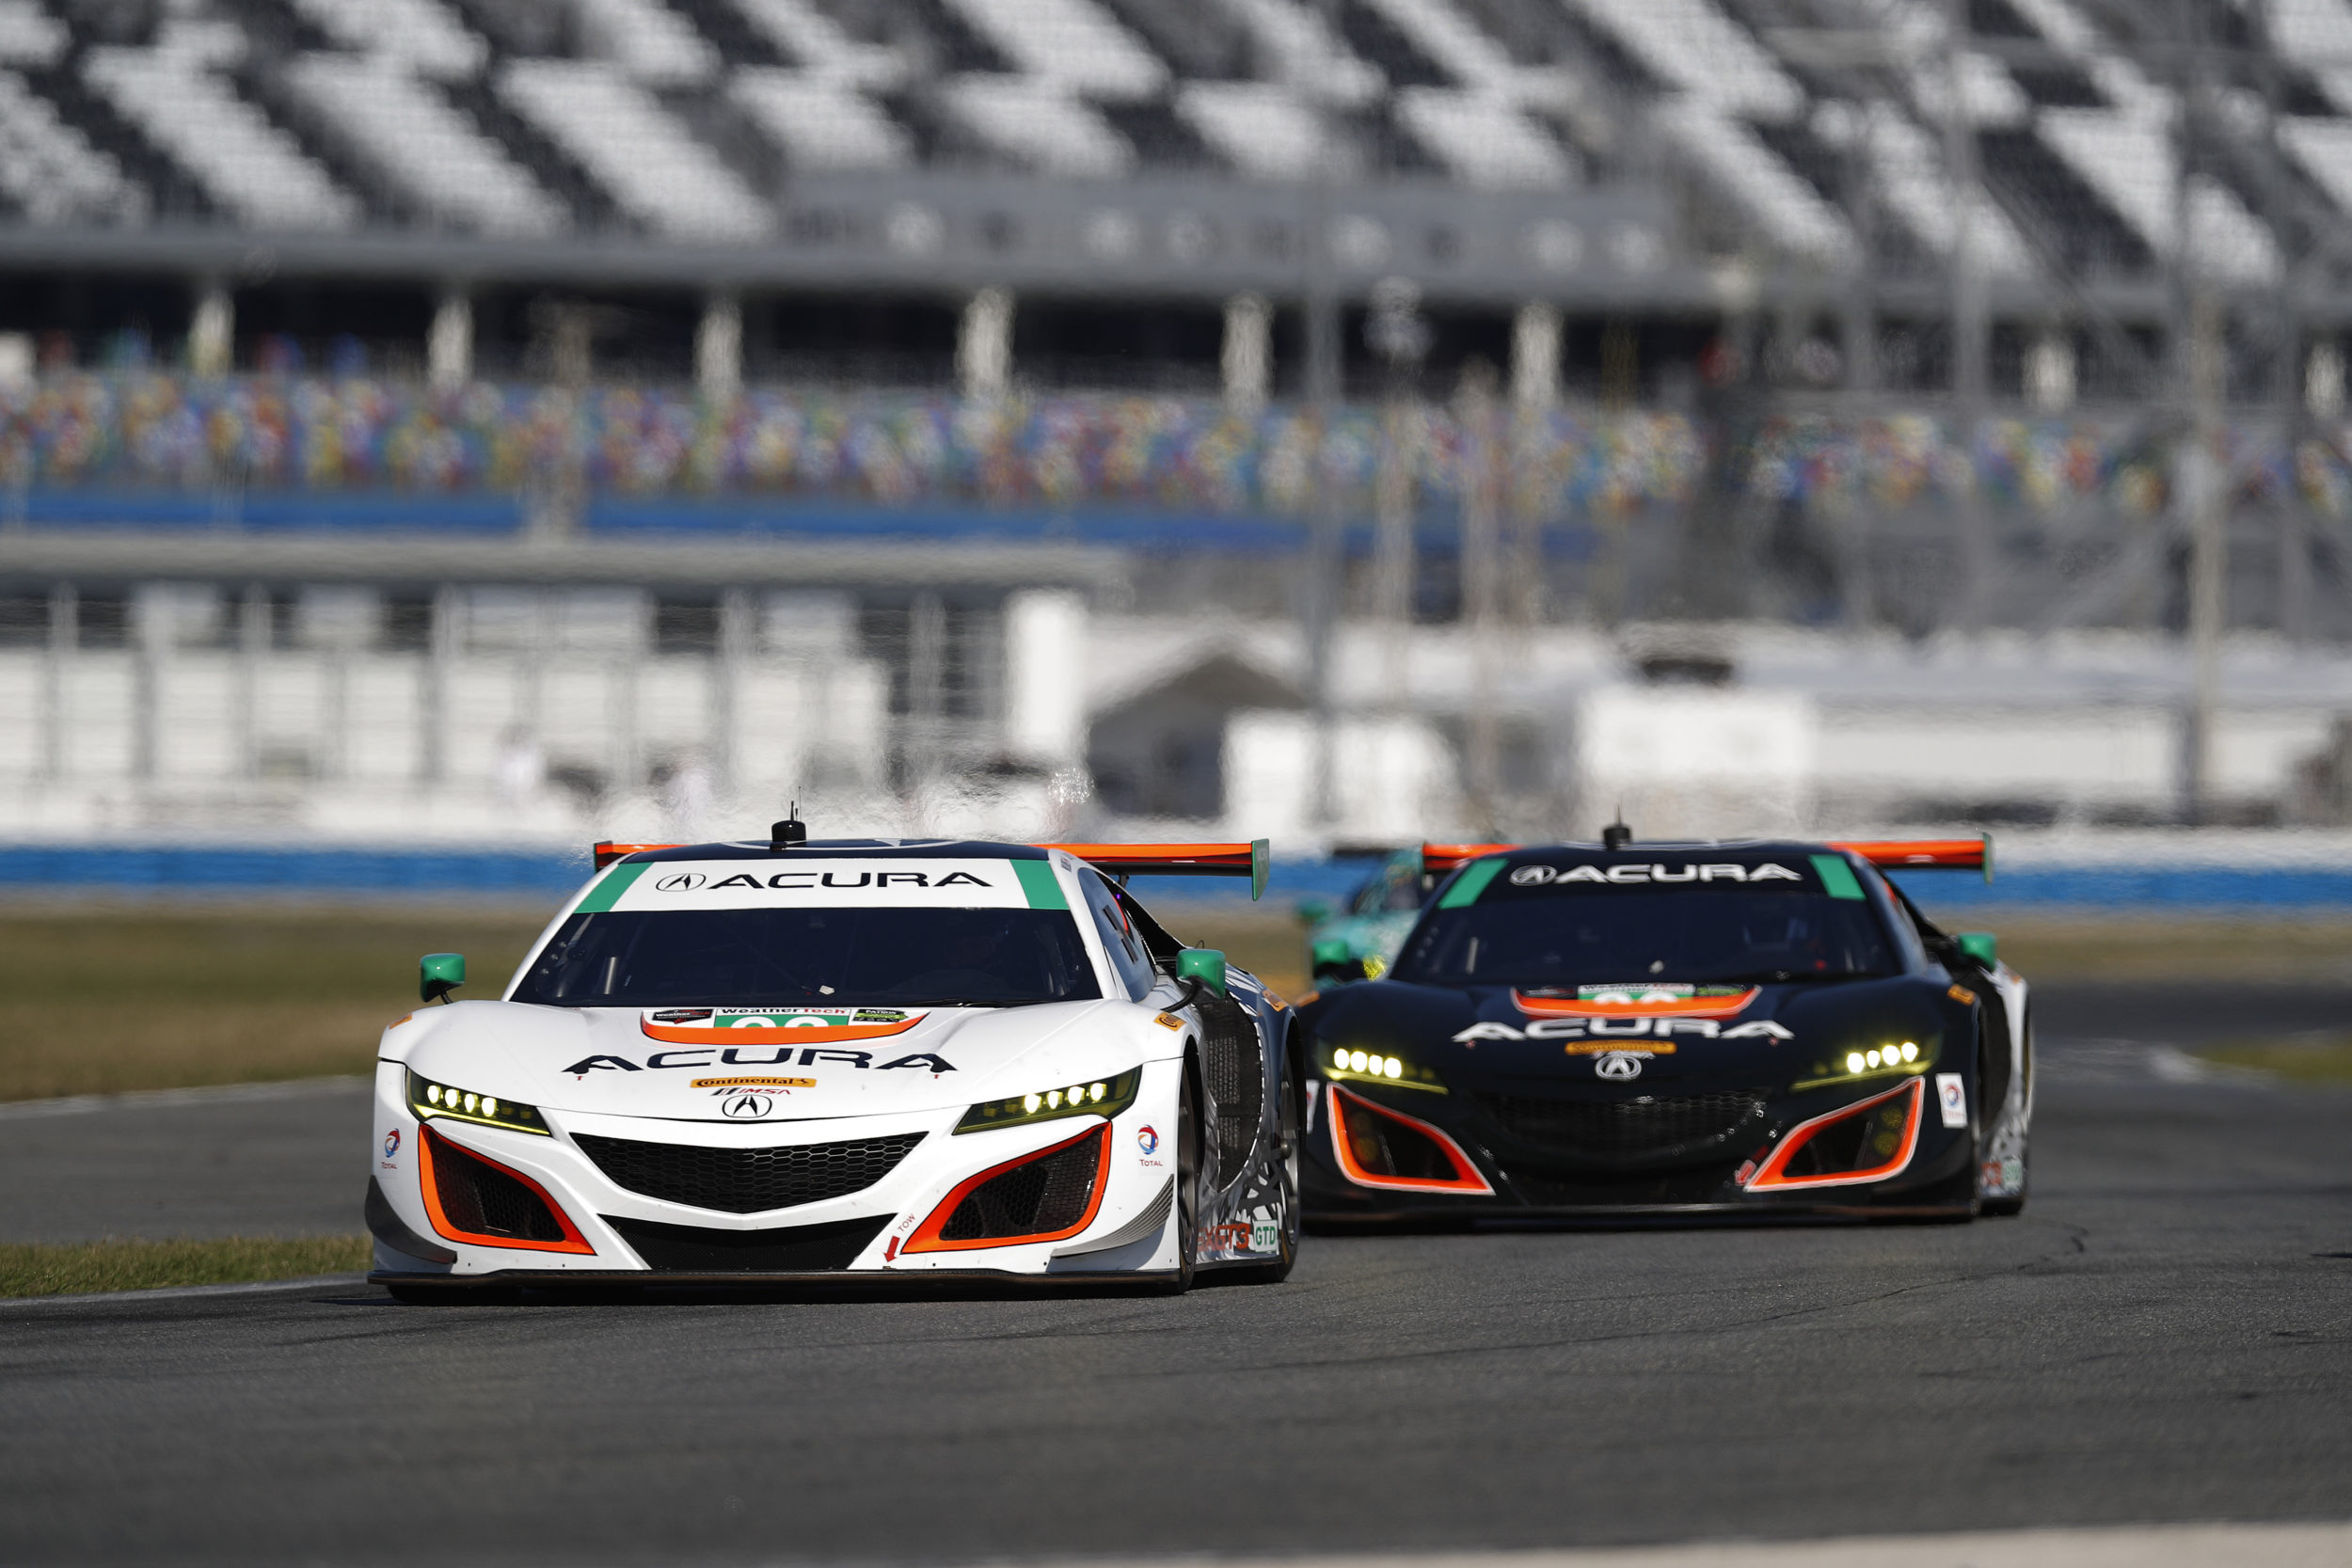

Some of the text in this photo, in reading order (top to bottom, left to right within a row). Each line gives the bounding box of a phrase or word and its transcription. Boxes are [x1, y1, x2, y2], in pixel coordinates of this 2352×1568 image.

[707, 872, 993, 889] ACURA
[1554, 863, 1803, 883] ACURA
[1451, 1017, 1795, 1041] ACURA
[561, 1048, 958, 1073] ACURA
[696, 1077, 793, 1086] Continental
[898, 1213, 915, 1232] TOW
[1255, 1226, 1278, 1246] GTD
